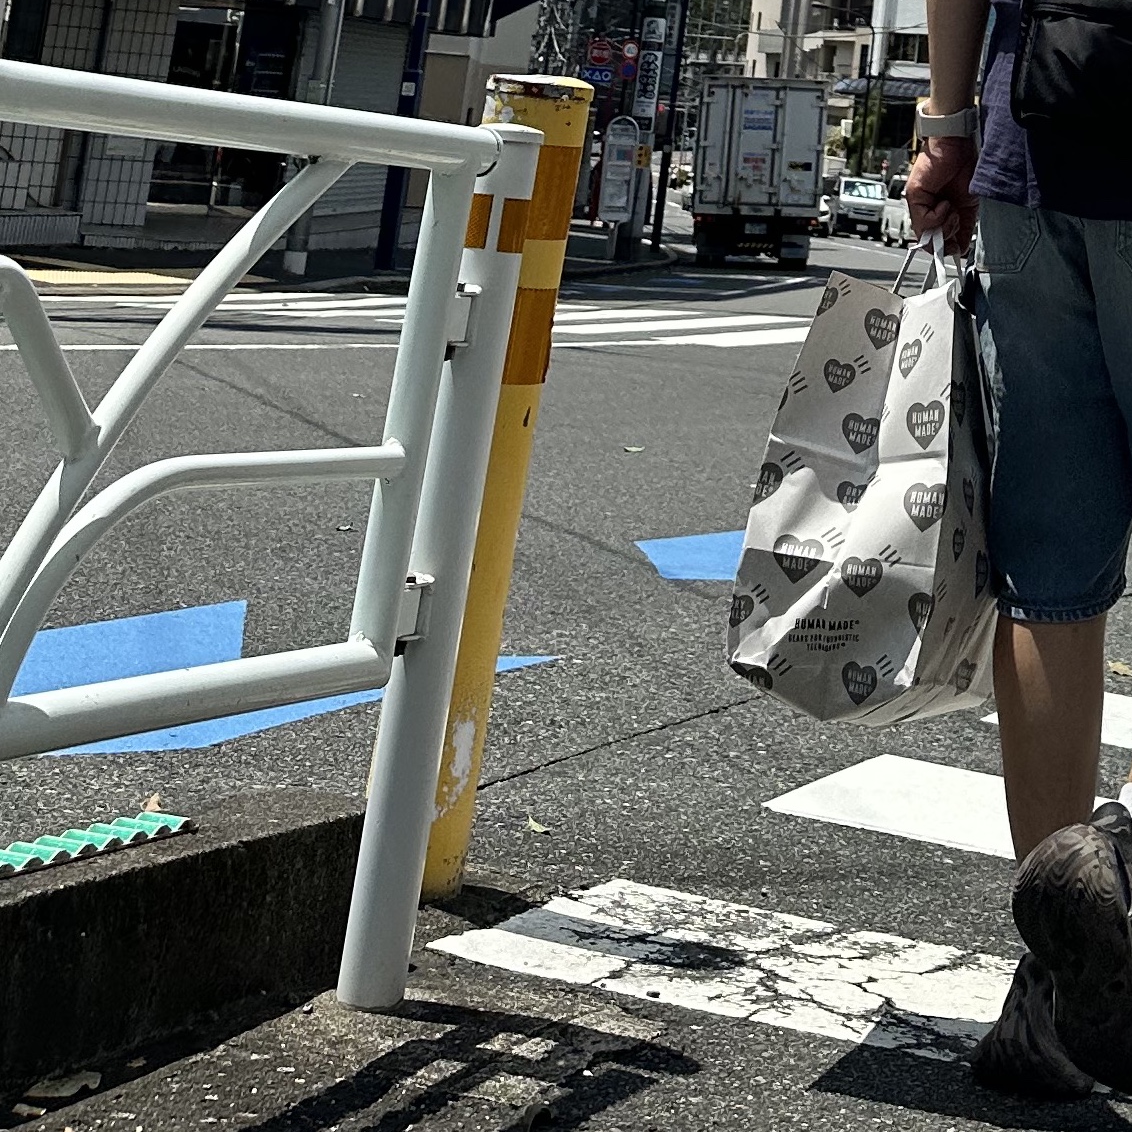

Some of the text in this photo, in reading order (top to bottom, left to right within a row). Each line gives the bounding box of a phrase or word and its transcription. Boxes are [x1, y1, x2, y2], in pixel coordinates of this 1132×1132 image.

[912, 409, 939, 423] HUMAN
[910, 491, 944, 505] HUMAN
[795, 618, 825, 630] HUMAN
